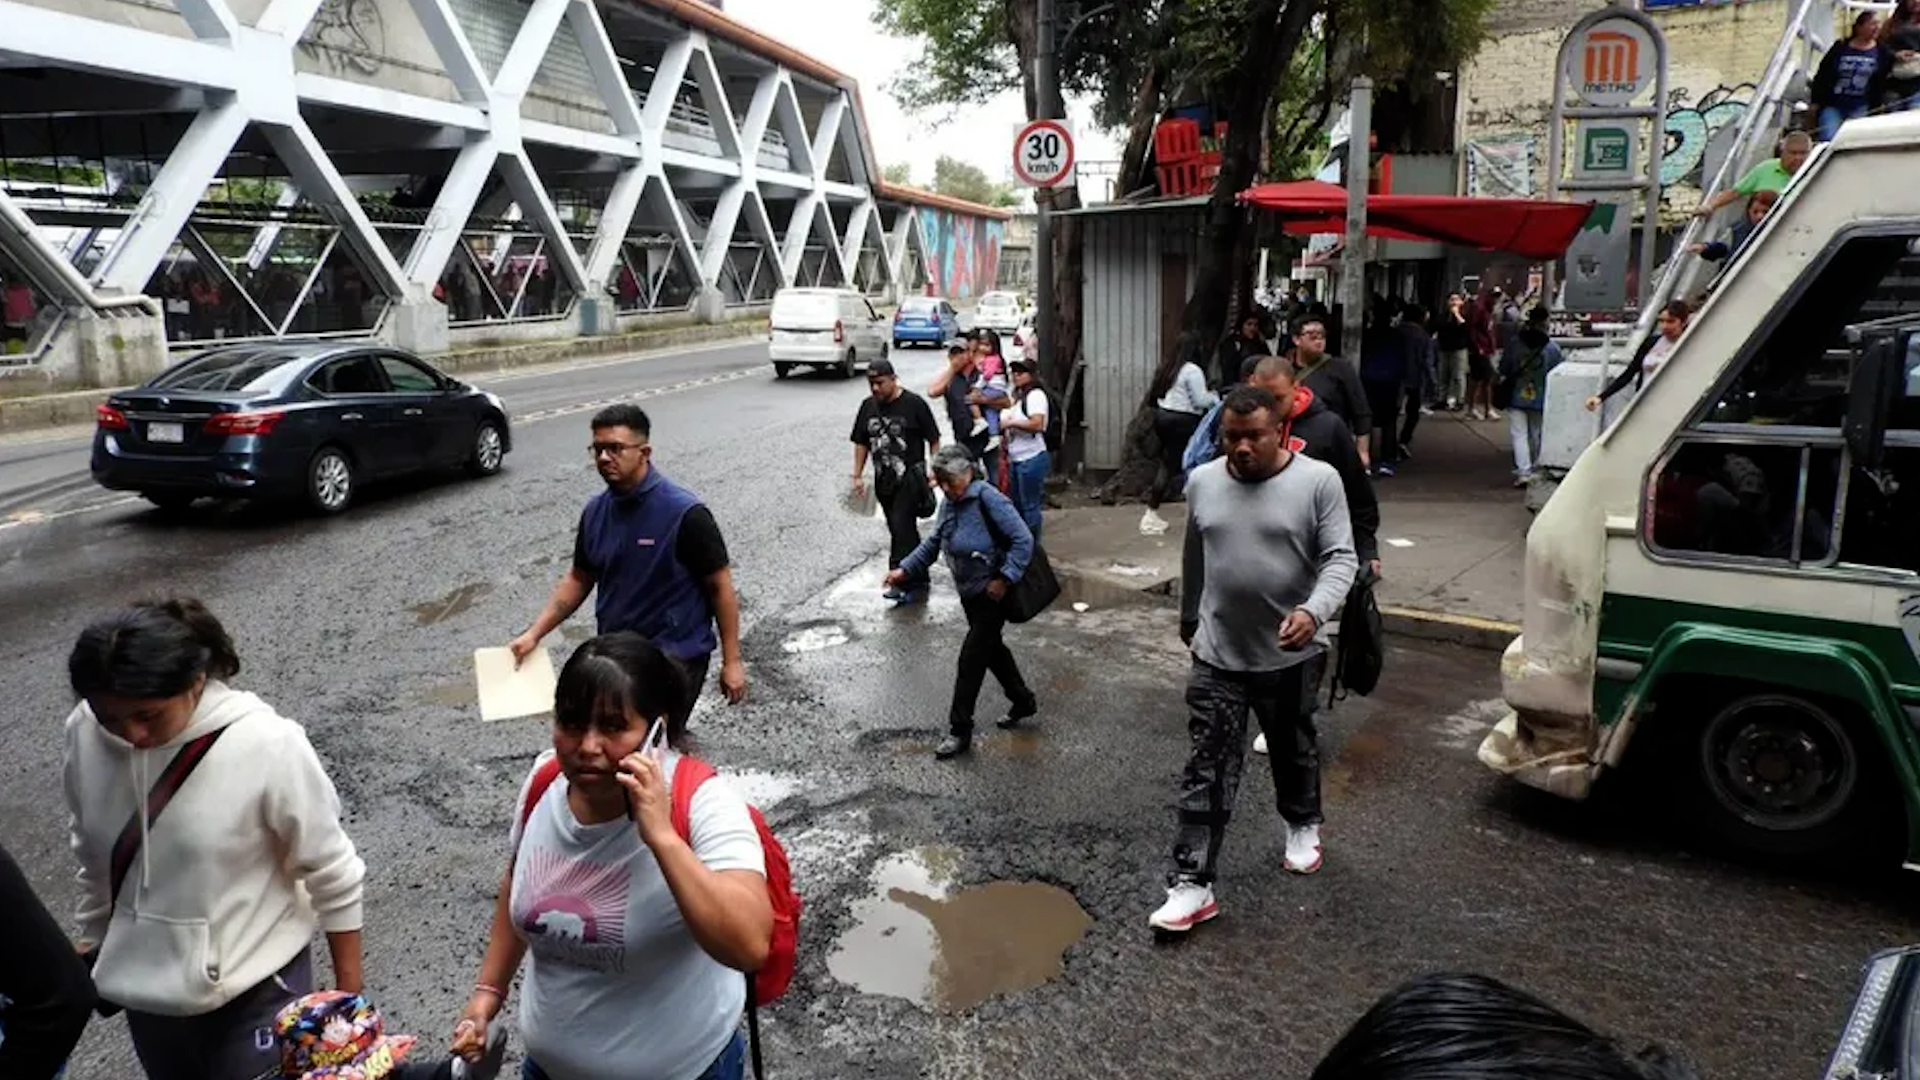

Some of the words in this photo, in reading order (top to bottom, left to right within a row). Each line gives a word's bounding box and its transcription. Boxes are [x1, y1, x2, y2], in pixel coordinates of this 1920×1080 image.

[1583, 82, 1636, 93] METRO
[1027, 133, 1059, 160] 30
[1027, 160, 1059, 173] km/h
